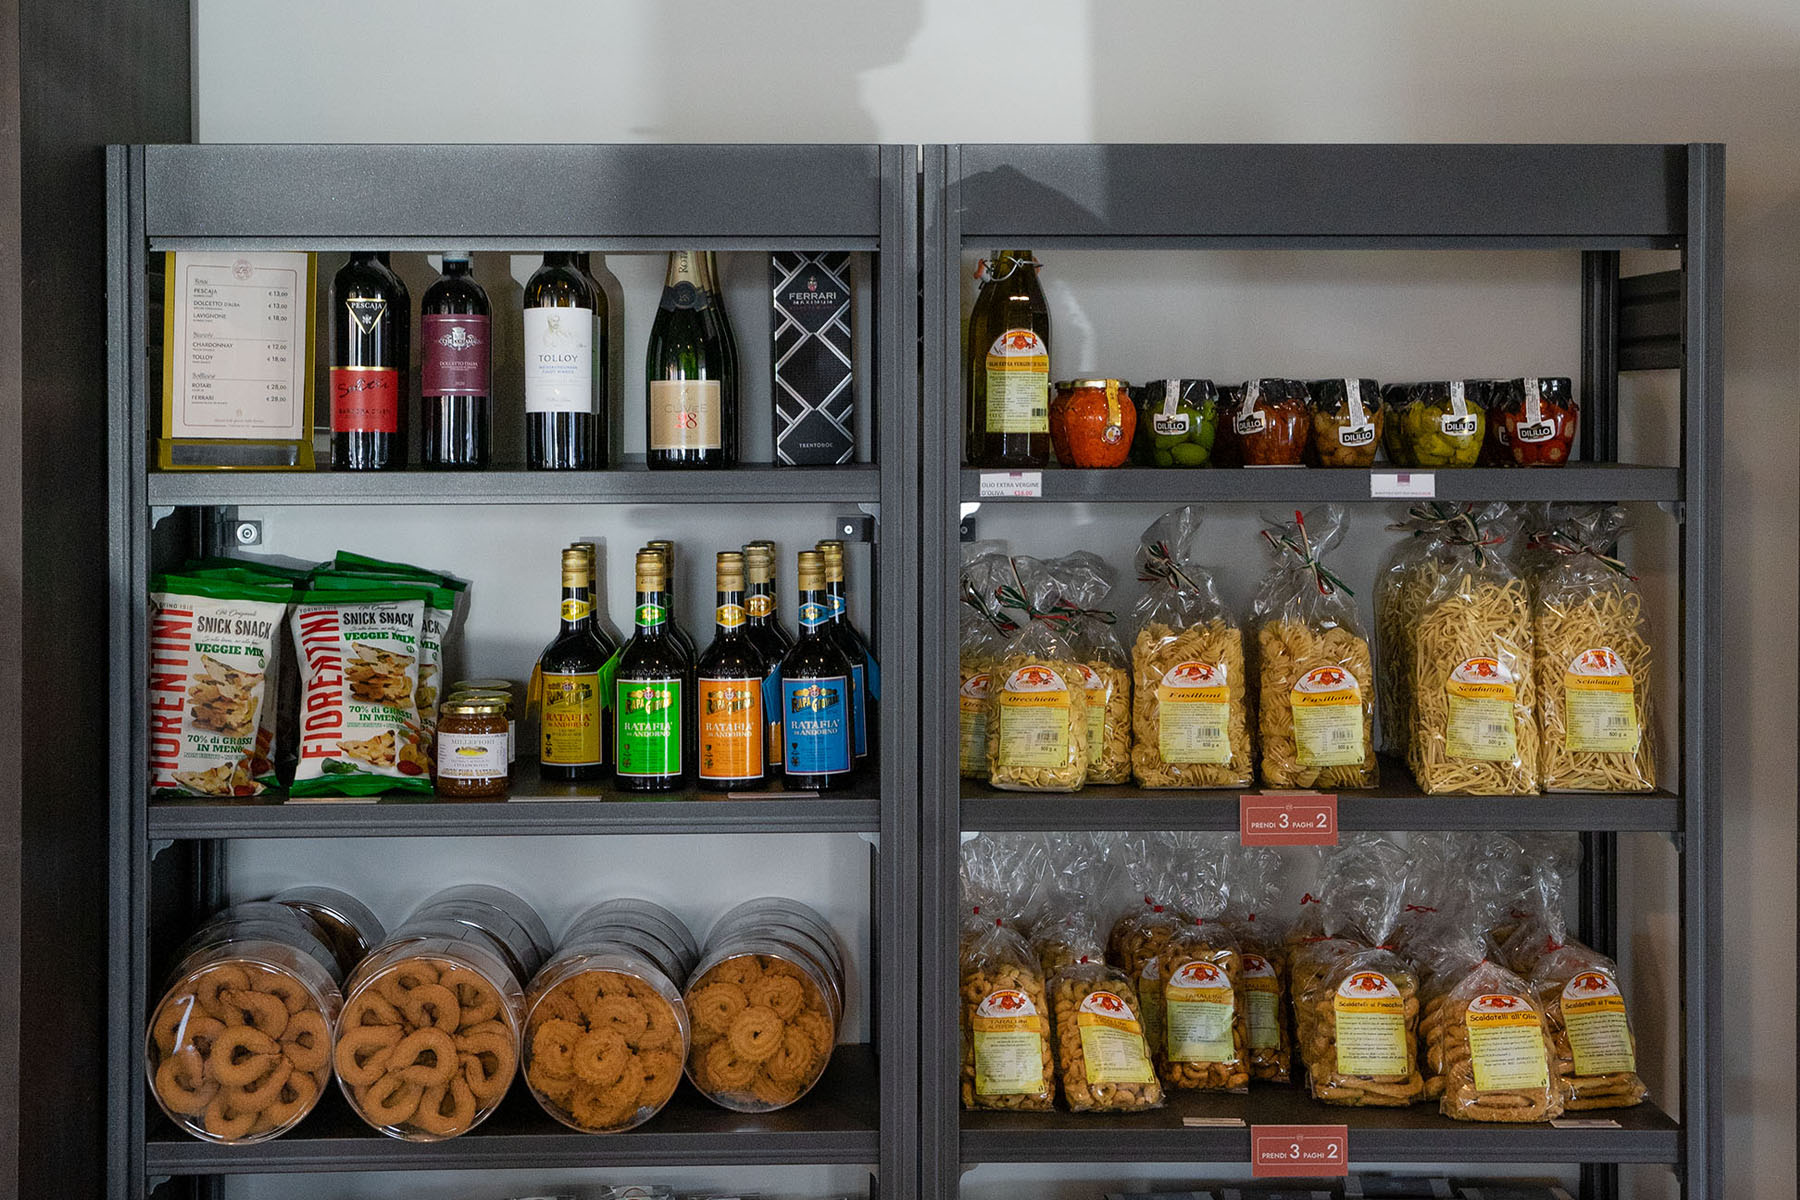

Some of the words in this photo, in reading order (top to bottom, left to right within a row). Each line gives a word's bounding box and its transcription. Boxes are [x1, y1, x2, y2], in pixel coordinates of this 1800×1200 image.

[789, 292, 836, 300] FERRARI
[351, 302, 382, 310] PESCAJA
[1157, 422, 1184, 431] DILILLO
[1239, 420, 1262, 430] DILILLO
[1446, 423, 1474, 432] DILILLO
[1344, 433, 1372, 442] DILILLO
[1520, 428, 1550, 437] DILILLO
[343, 612, 376, 625] SNICK
[380, 612, 414, 628] SNACK
[197, 616, 231, 634] SNICK
[235, 619, 272, 640] SNACK
[344, 632, 389, 641] VEGGIE
[392, 633, 415, 644] MIX
[194, 642, 241, 655] VEGGIE
[245, 645, 264, 658] MIX
[420, 640, 439, 652] MIX
[300, 610, 343, 758] FIORENTINI
[625, 699, 644, 715] RAPA
[792, 697, 811, 714] RAPA
[382, 706, 412, 720] GRASSI
[187, 734, 207, 744] 70%
[210, 735, 219, 744] di
[222, 735, 252, 745] GRASSI
[197, 744, 212, 752] IN
[1279, 813, 1289, 828] 3
[1316, 813, 1327, 828] 2
[1290, 1144, 1300, 1159] 3
[1327, 1144, 1338, 1158] 2
